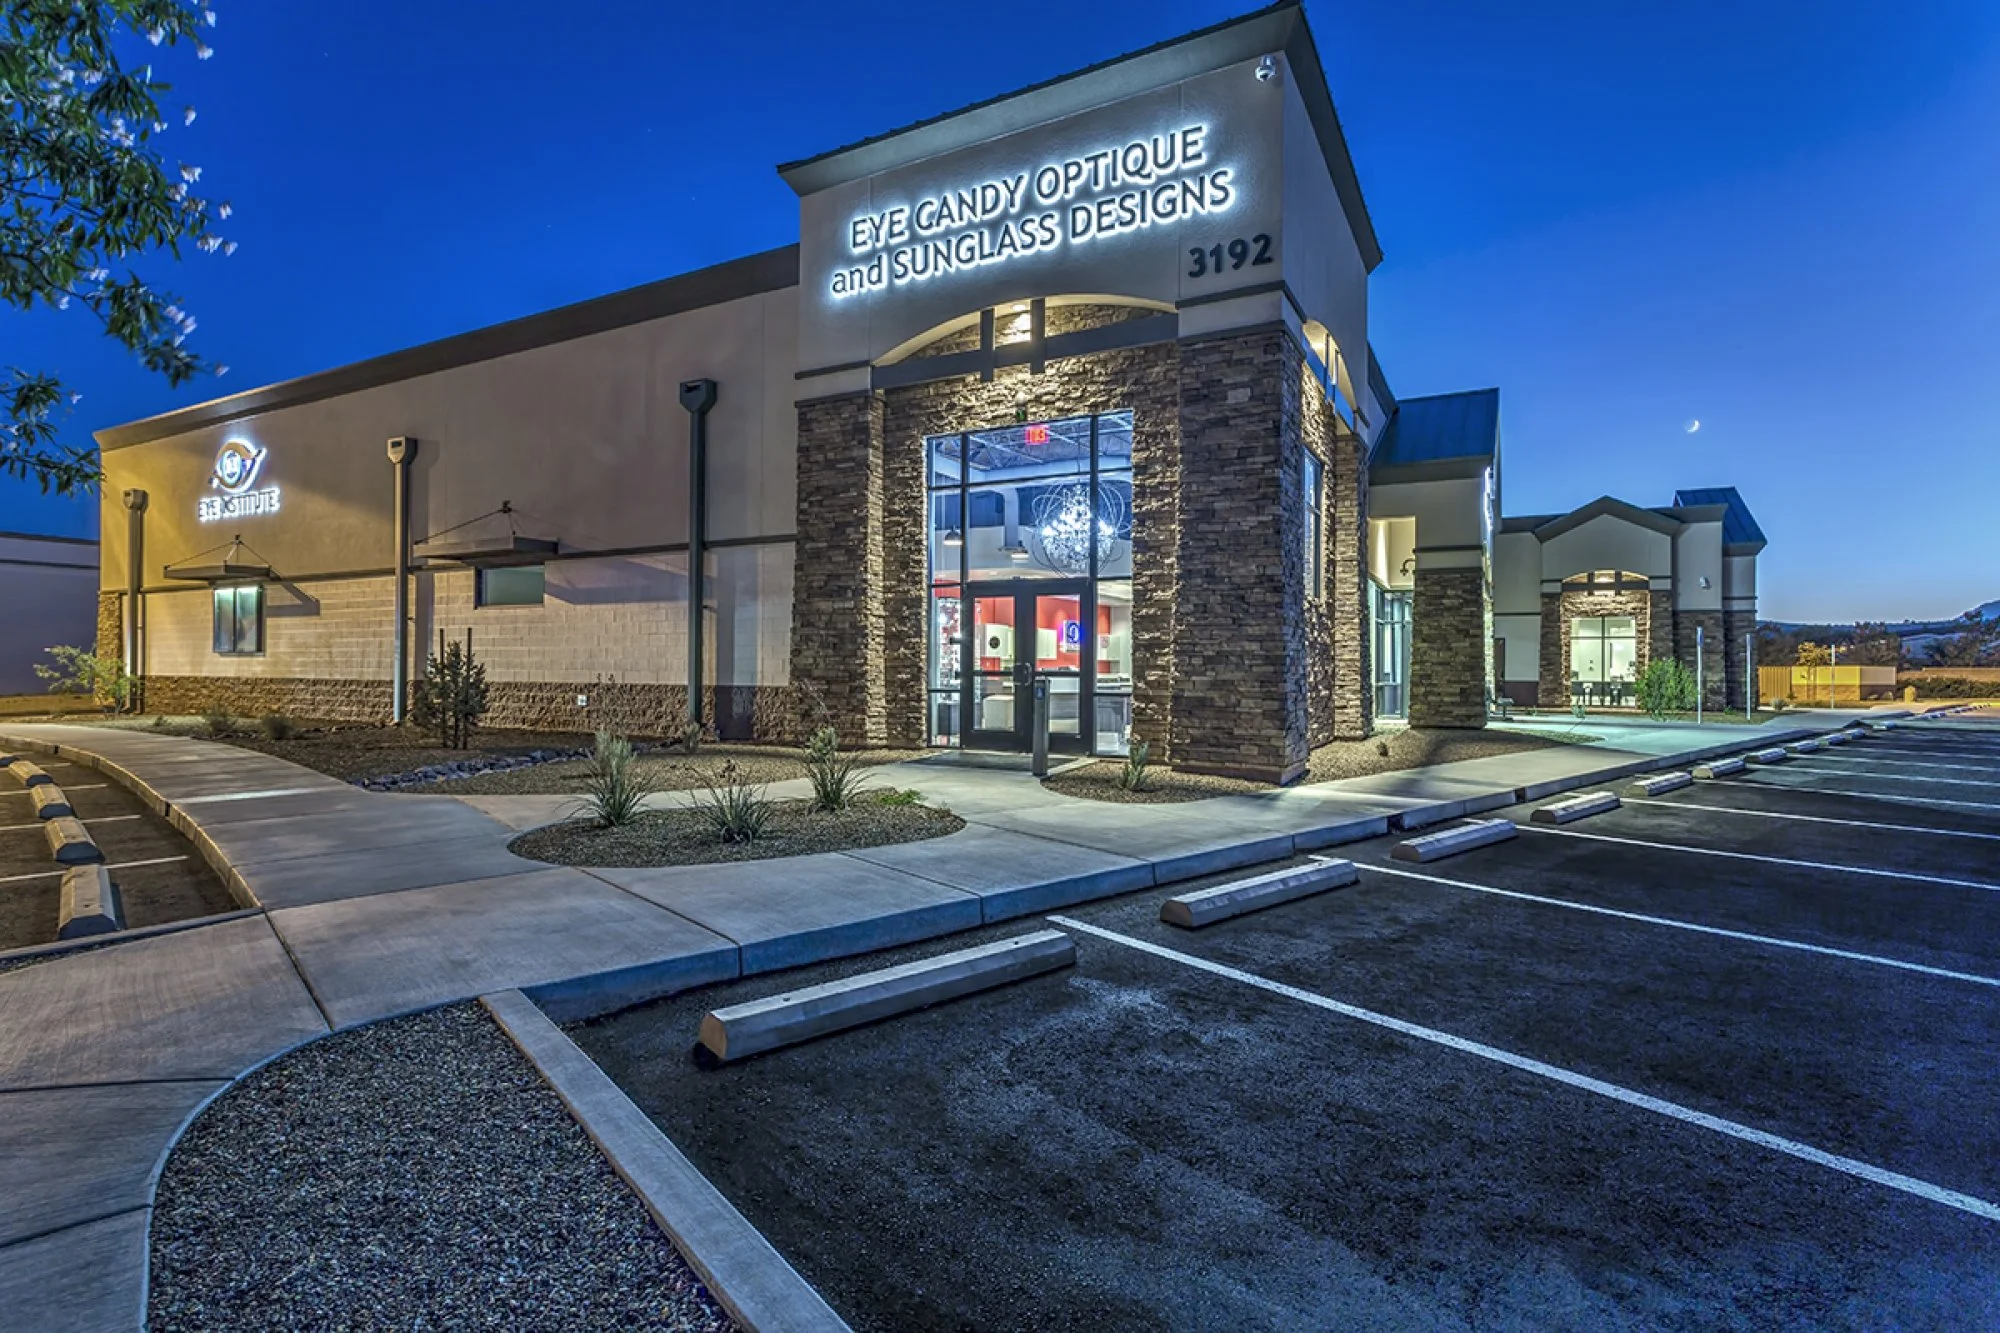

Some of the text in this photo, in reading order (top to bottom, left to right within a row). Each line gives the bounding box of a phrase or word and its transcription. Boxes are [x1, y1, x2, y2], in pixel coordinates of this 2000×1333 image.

[832, 170, 1231, 294] and SUNGLASS DESIGNS
[852, 126, 1204, 249] EYE CANDY OPTIQUE
[1188, 234, 1274, 278] 3192
